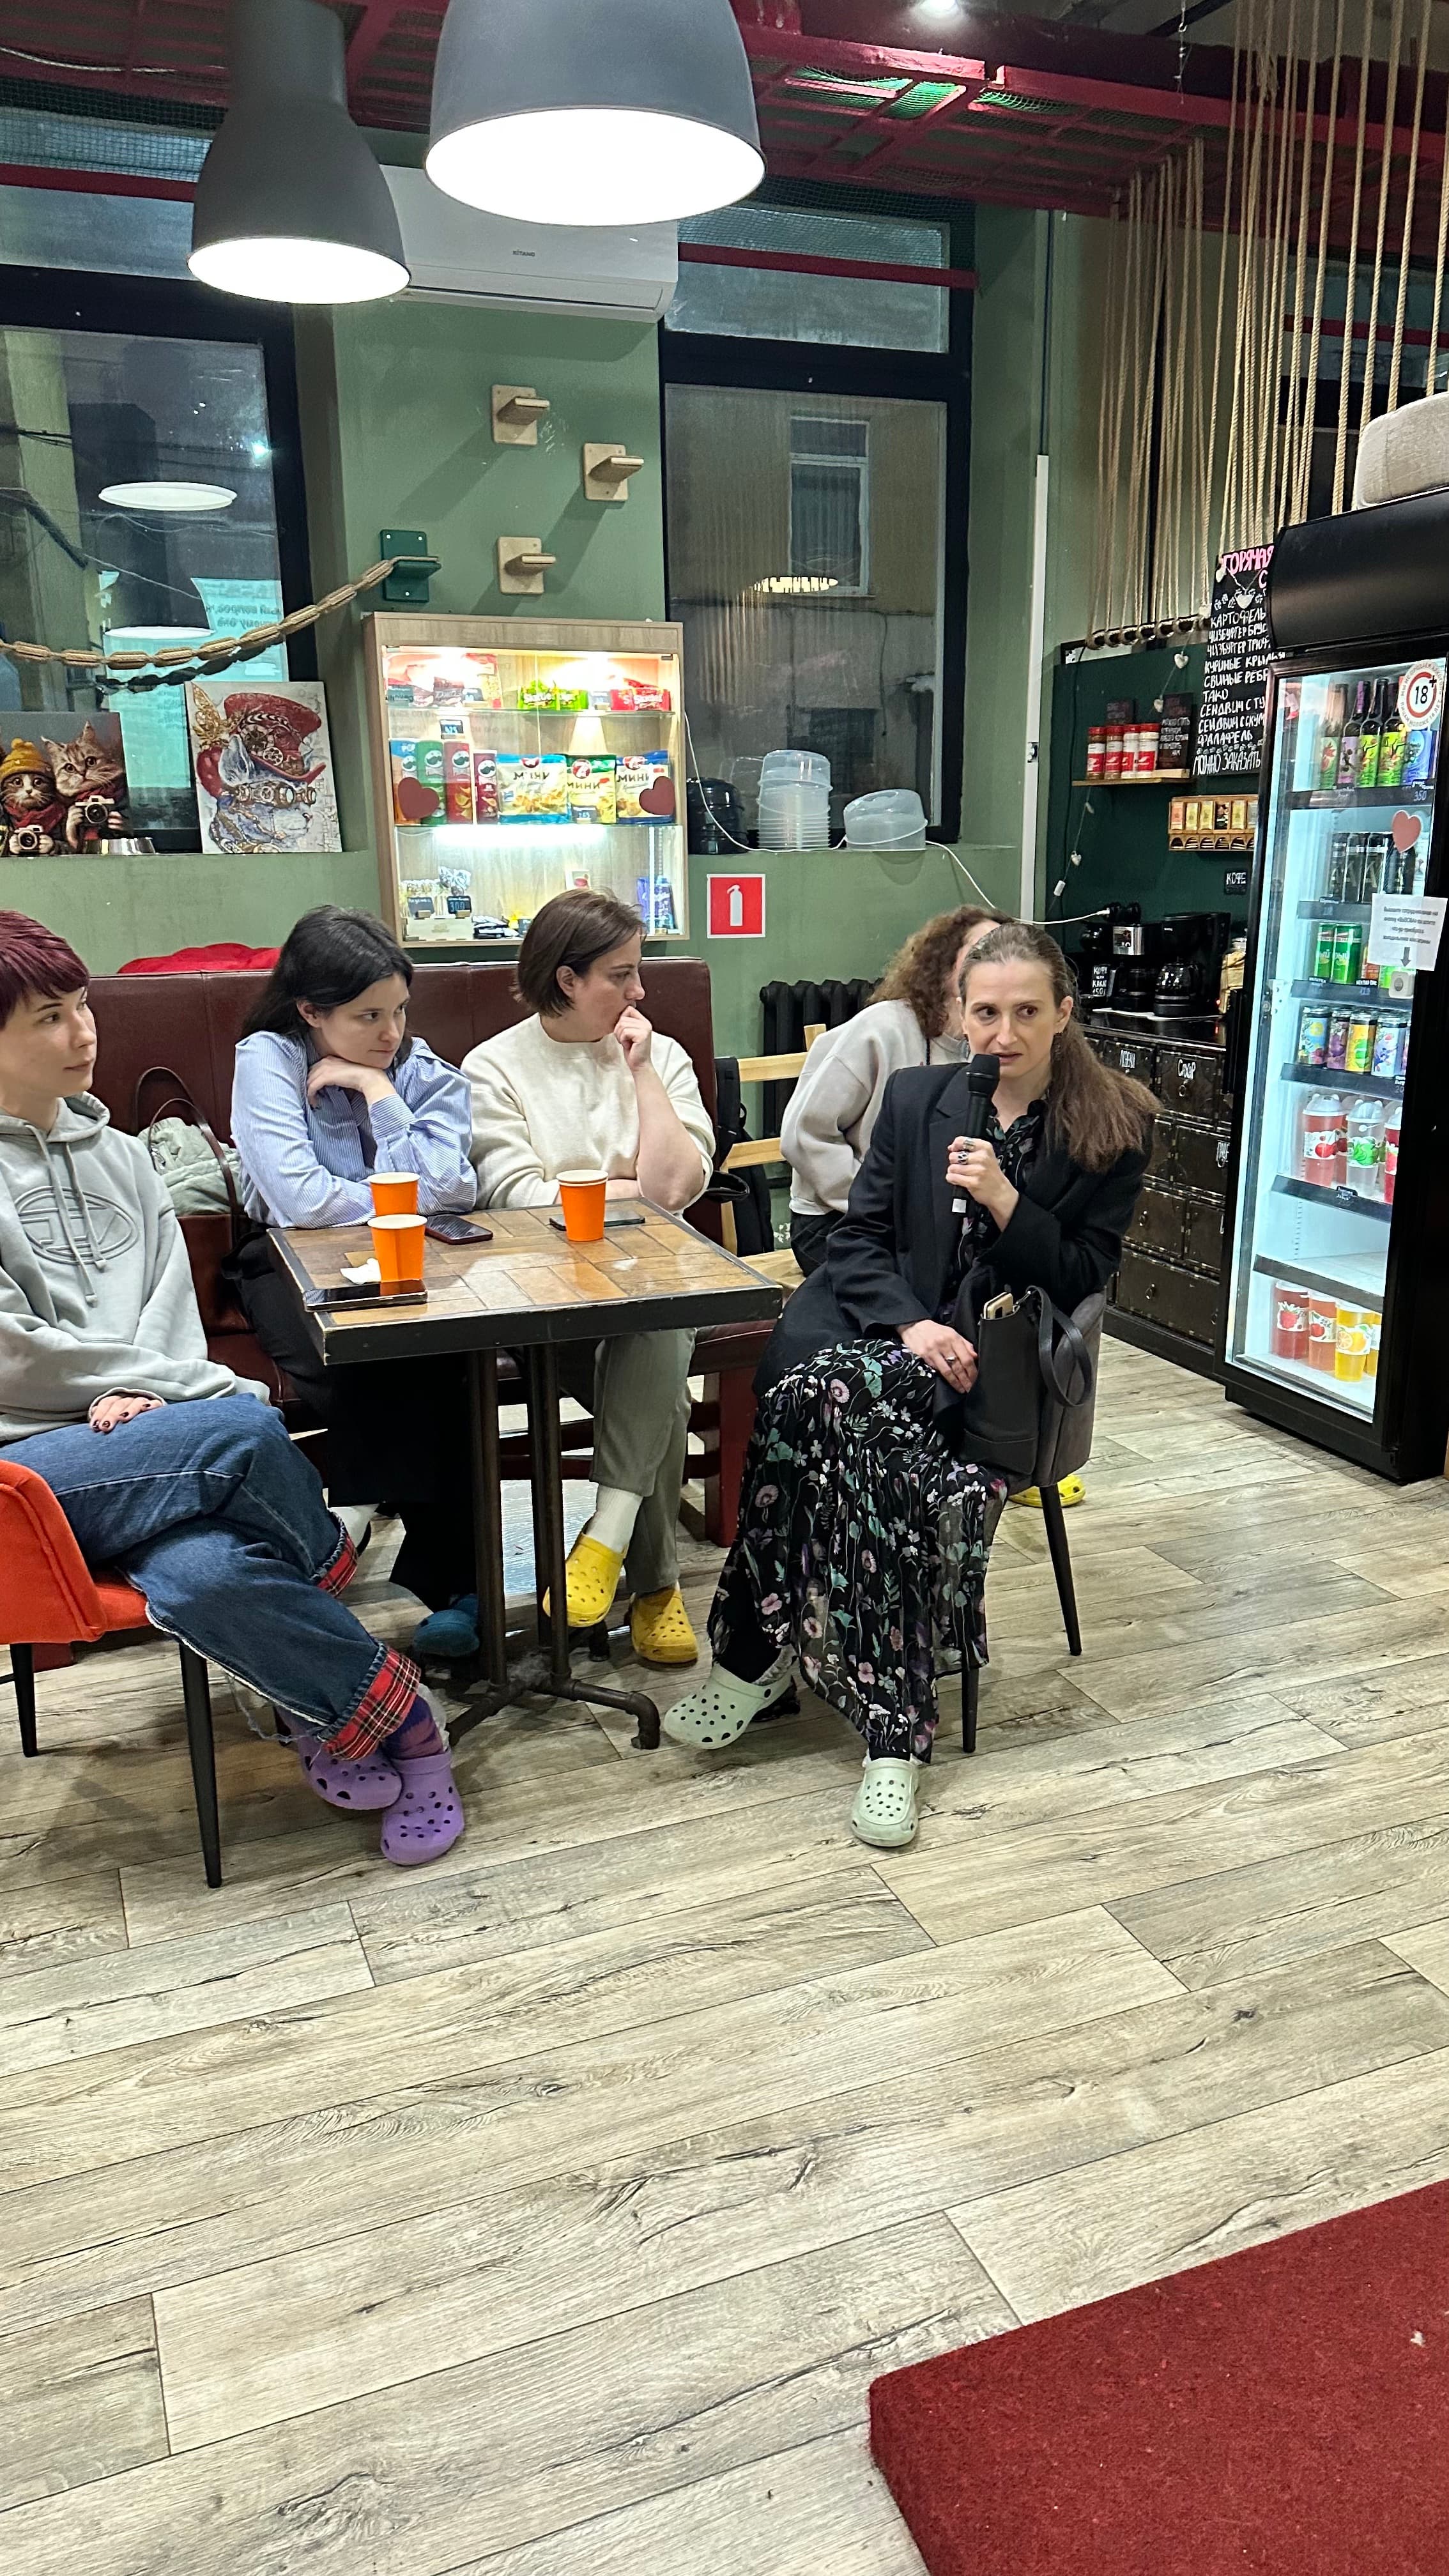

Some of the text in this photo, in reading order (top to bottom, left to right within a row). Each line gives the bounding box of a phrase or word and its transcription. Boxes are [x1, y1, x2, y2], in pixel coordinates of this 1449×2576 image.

[1222, 545, 1275, 574] ГОРЯЧАЯ
[1211, 608, 1266, 628] КАРТОФЕЛЬ
[1209, 626, 1247, 643] ЧИЗБУРГЕР
[1207, 641, 1246, 657] ЧИЗБУРГЕР
[1204, 657, 1242, 674] КУРИНЫЕ
[1204, 671, 1243, 689] СВИНЫЕ
[1202, 688, 1228, 703] ТАКО
[1200, 700, 1244, 717] СЕНДВИЧ
[1245, 698, 1252, 710] С
[1198, 716, 1239, 734] СЕНДВИЧ
[1197, 730, 1254, 747] ФАЛАФЕЛЬ
[1192, 751, 1261, 775] МОЖНО ЗАКАЗАТЬ
[1226, 871, 1246, 885] КОФЕ
